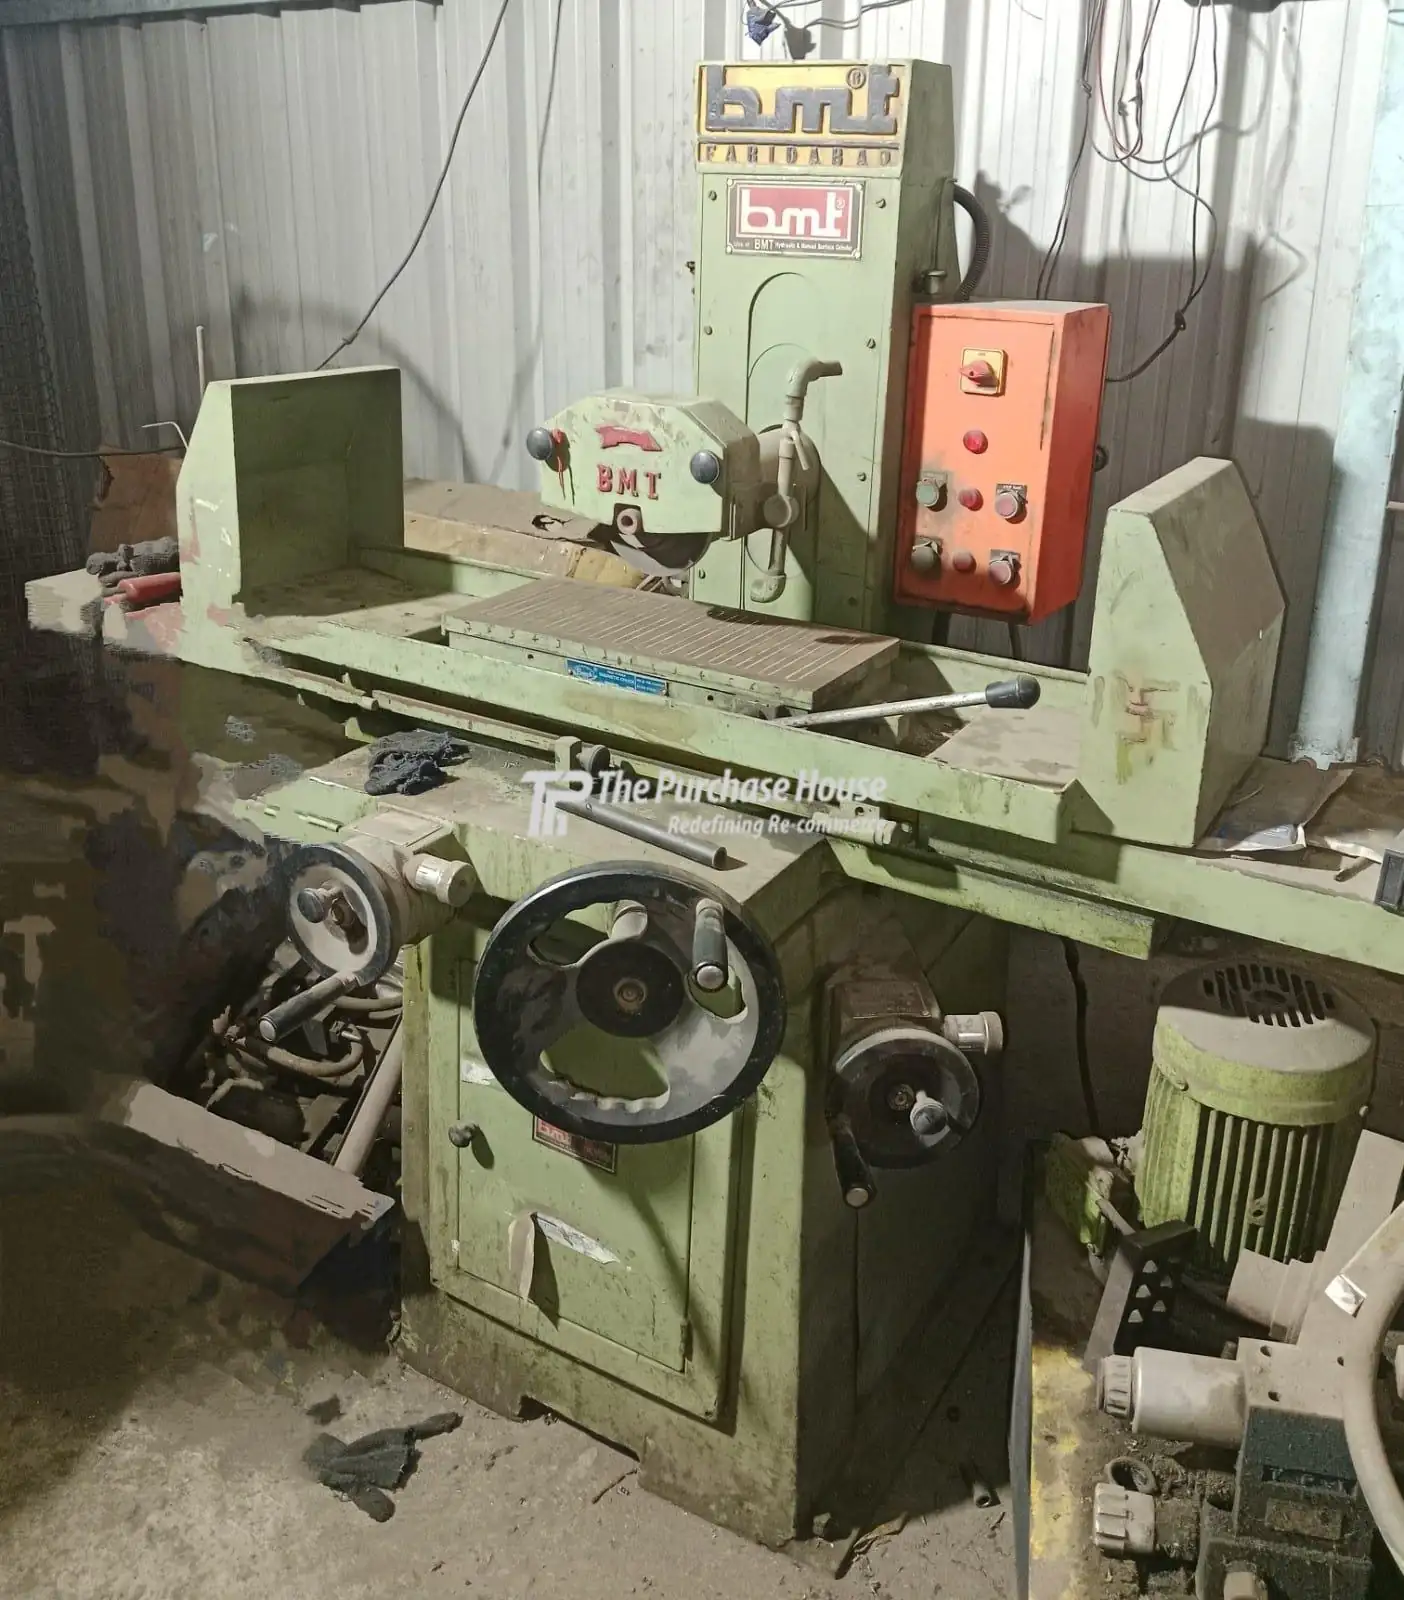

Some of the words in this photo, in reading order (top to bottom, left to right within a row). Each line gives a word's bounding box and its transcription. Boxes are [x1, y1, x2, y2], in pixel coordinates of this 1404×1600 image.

[704, 145, 892, 166] FARIDABAD
[754, 239, 774, 250] BMT
[597, 464, 661, 500] BMT
